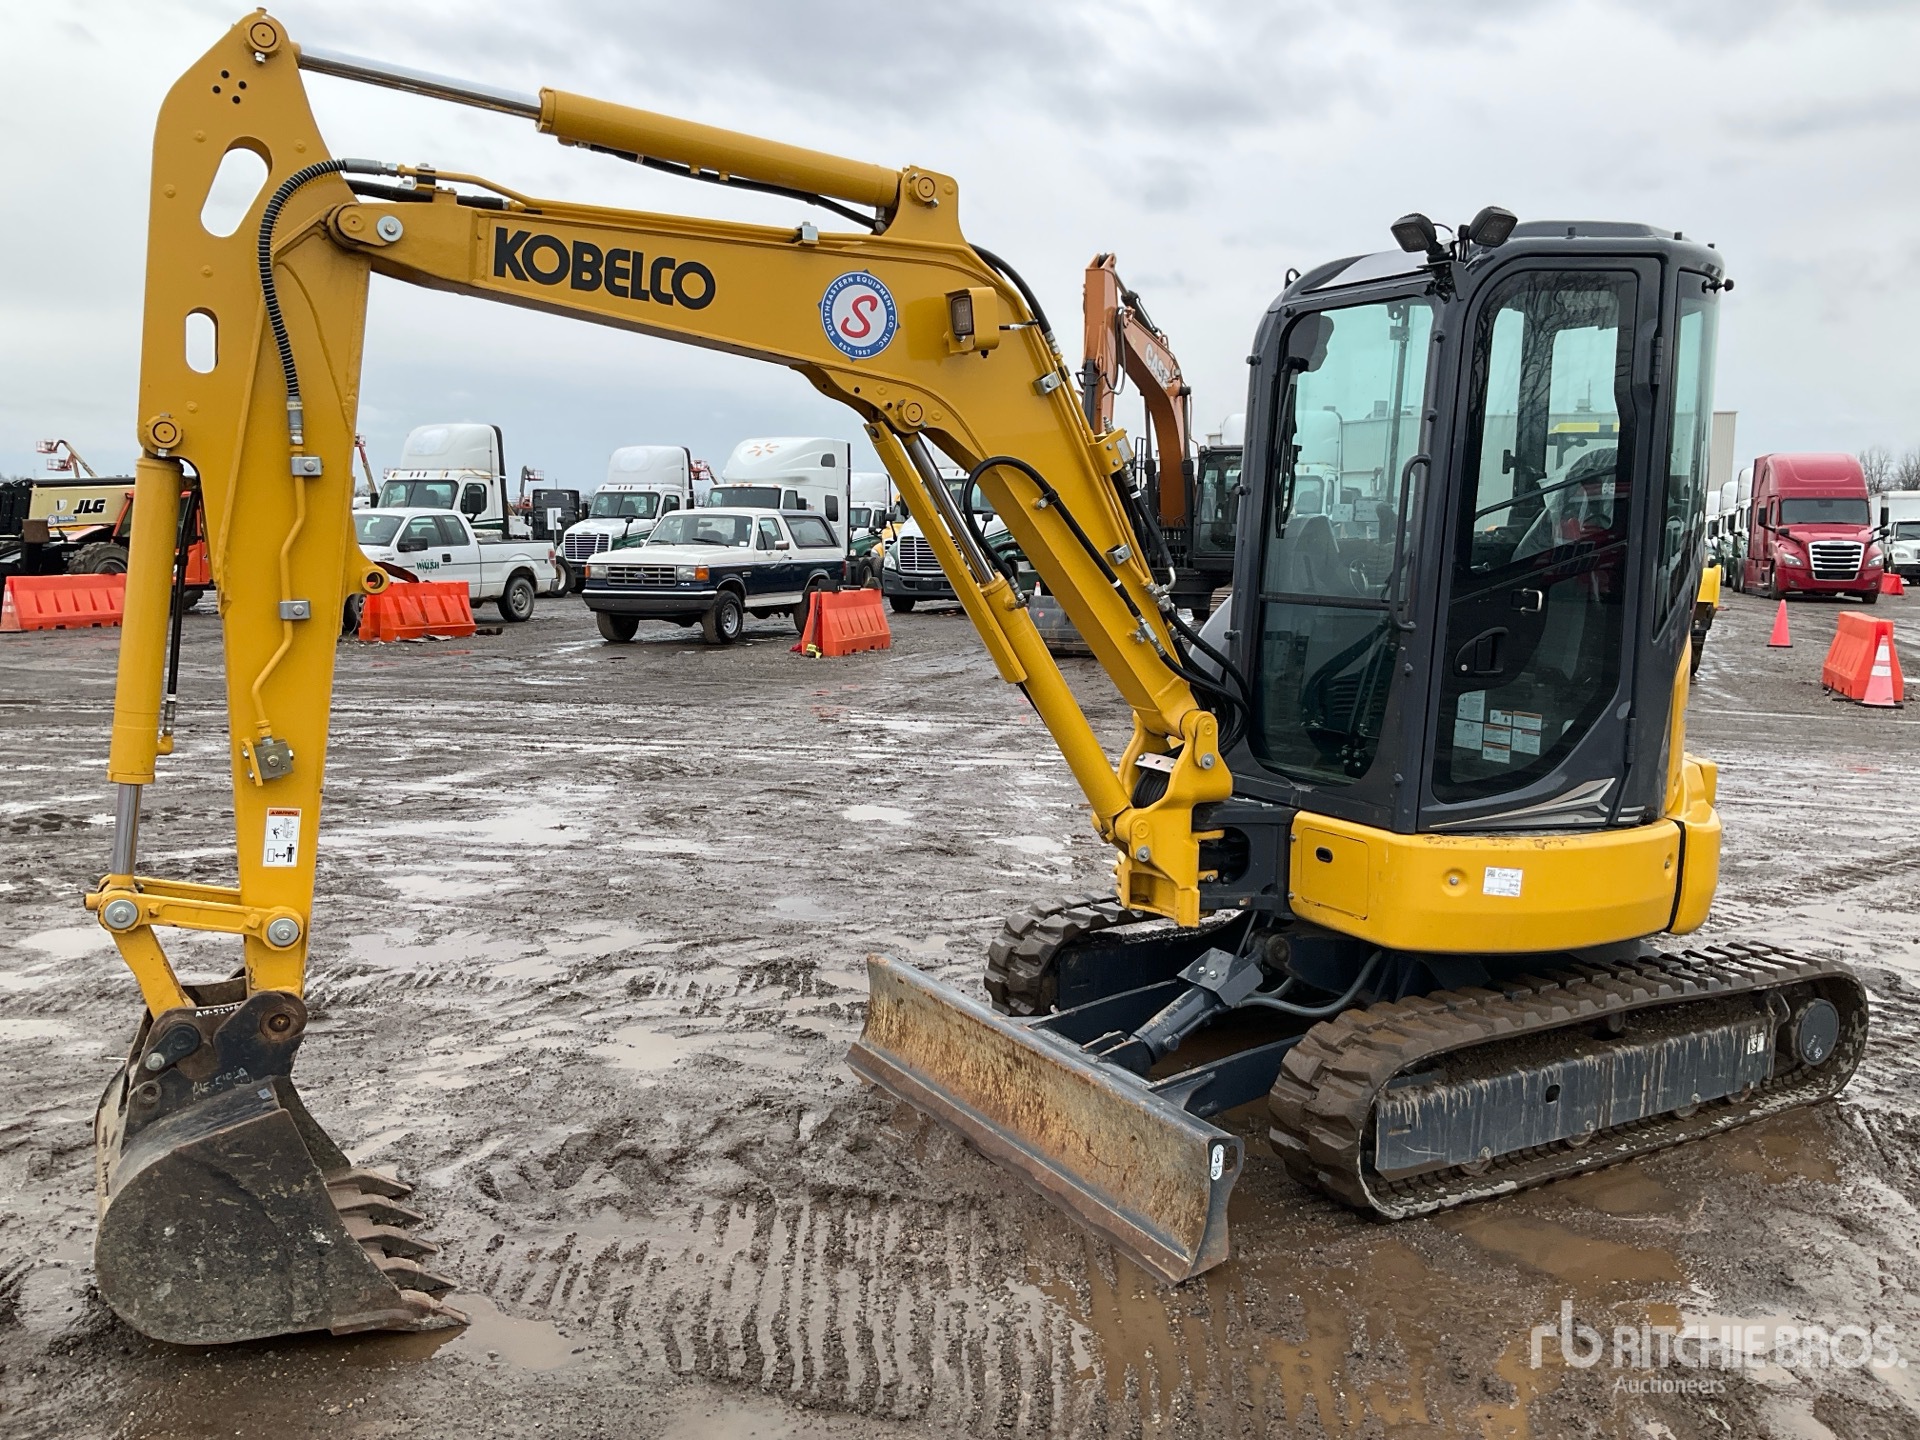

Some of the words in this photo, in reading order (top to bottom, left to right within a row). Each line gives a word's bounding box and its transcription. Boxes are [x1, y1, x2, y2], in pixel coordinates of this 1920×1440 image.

[493, 226, 716, 310] KOBELCO
[824, 276, 853, 336] SOUTHEASTERN
[856, 275, 894, 312] EQUIPMENT
[841, 295, 878, 338] S
[1145, 343, 1171, 390] CASE
[73, 499, 105, 514] JLG
